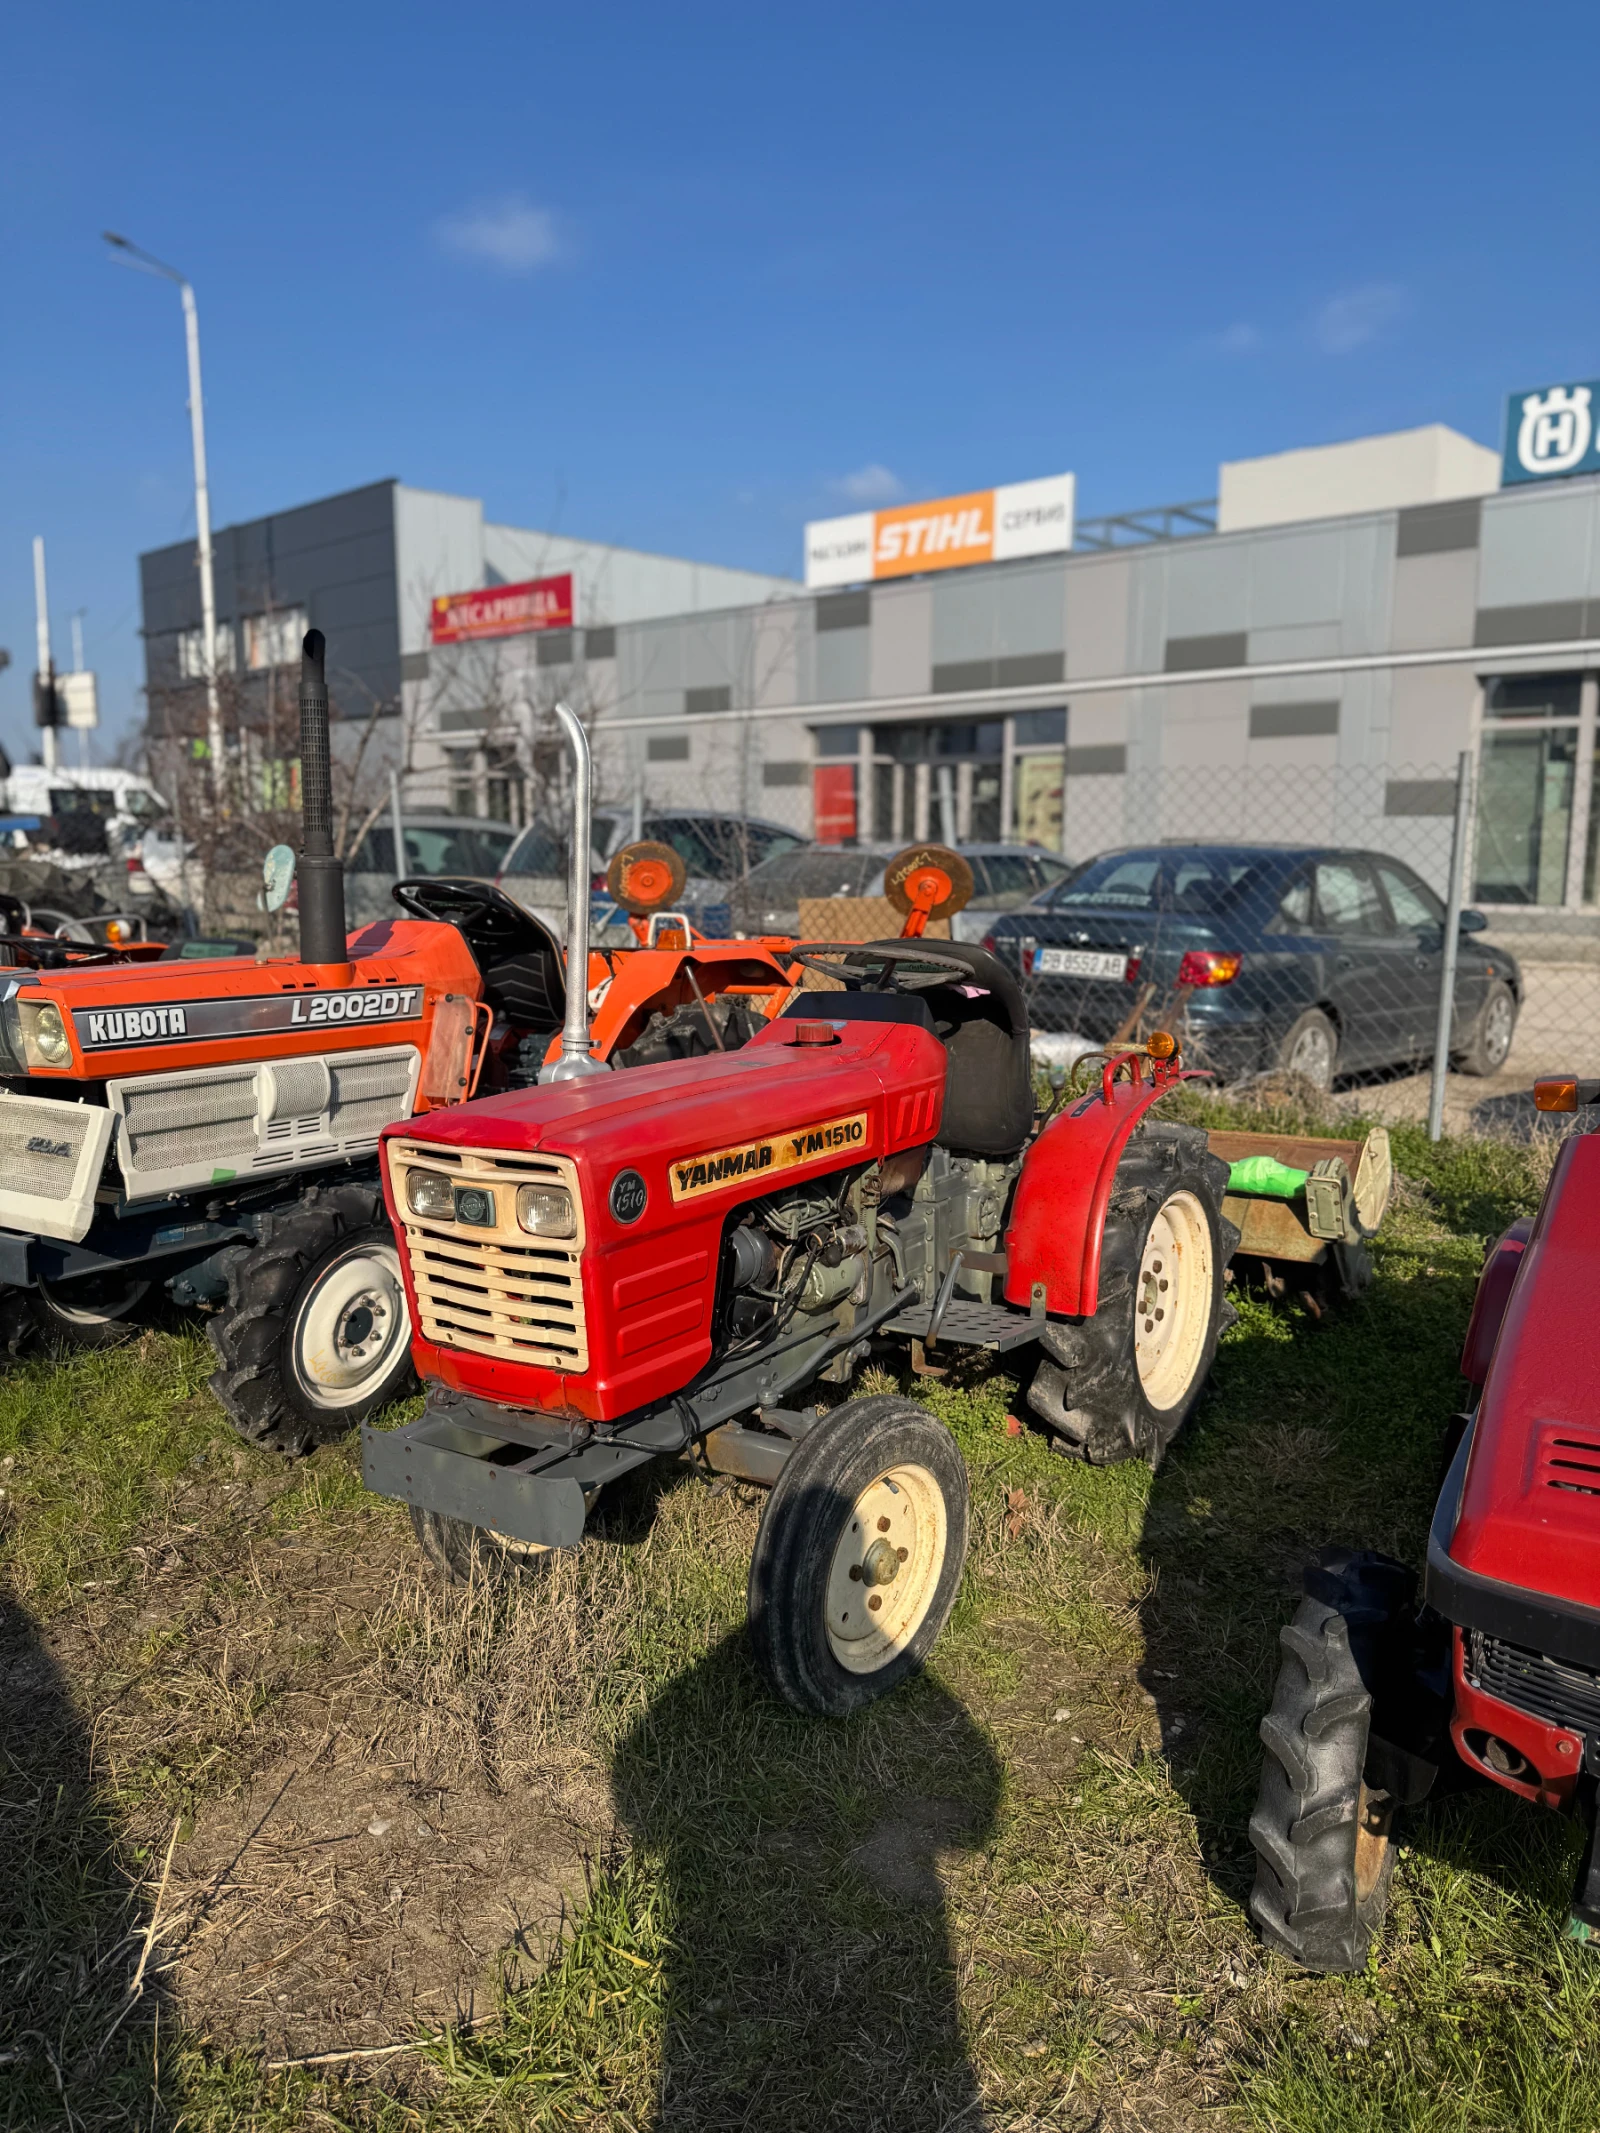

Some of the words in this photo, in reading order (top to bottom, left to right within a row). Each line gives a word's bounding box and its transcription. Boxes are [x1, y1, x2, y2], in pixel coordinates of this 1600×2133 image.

[876, 508, 991, 562] STIHL
[88, 1008, 187, 1043] KUBOTA
[290, 990, 417, 1025] L2002DT
[676, 1145, 773, 1192] YANMAR
[791, 1121, 863, 1157] YM1510
[616, 1189, 644, 1213] 1510
[619, 1179, 636, 1193] YM
